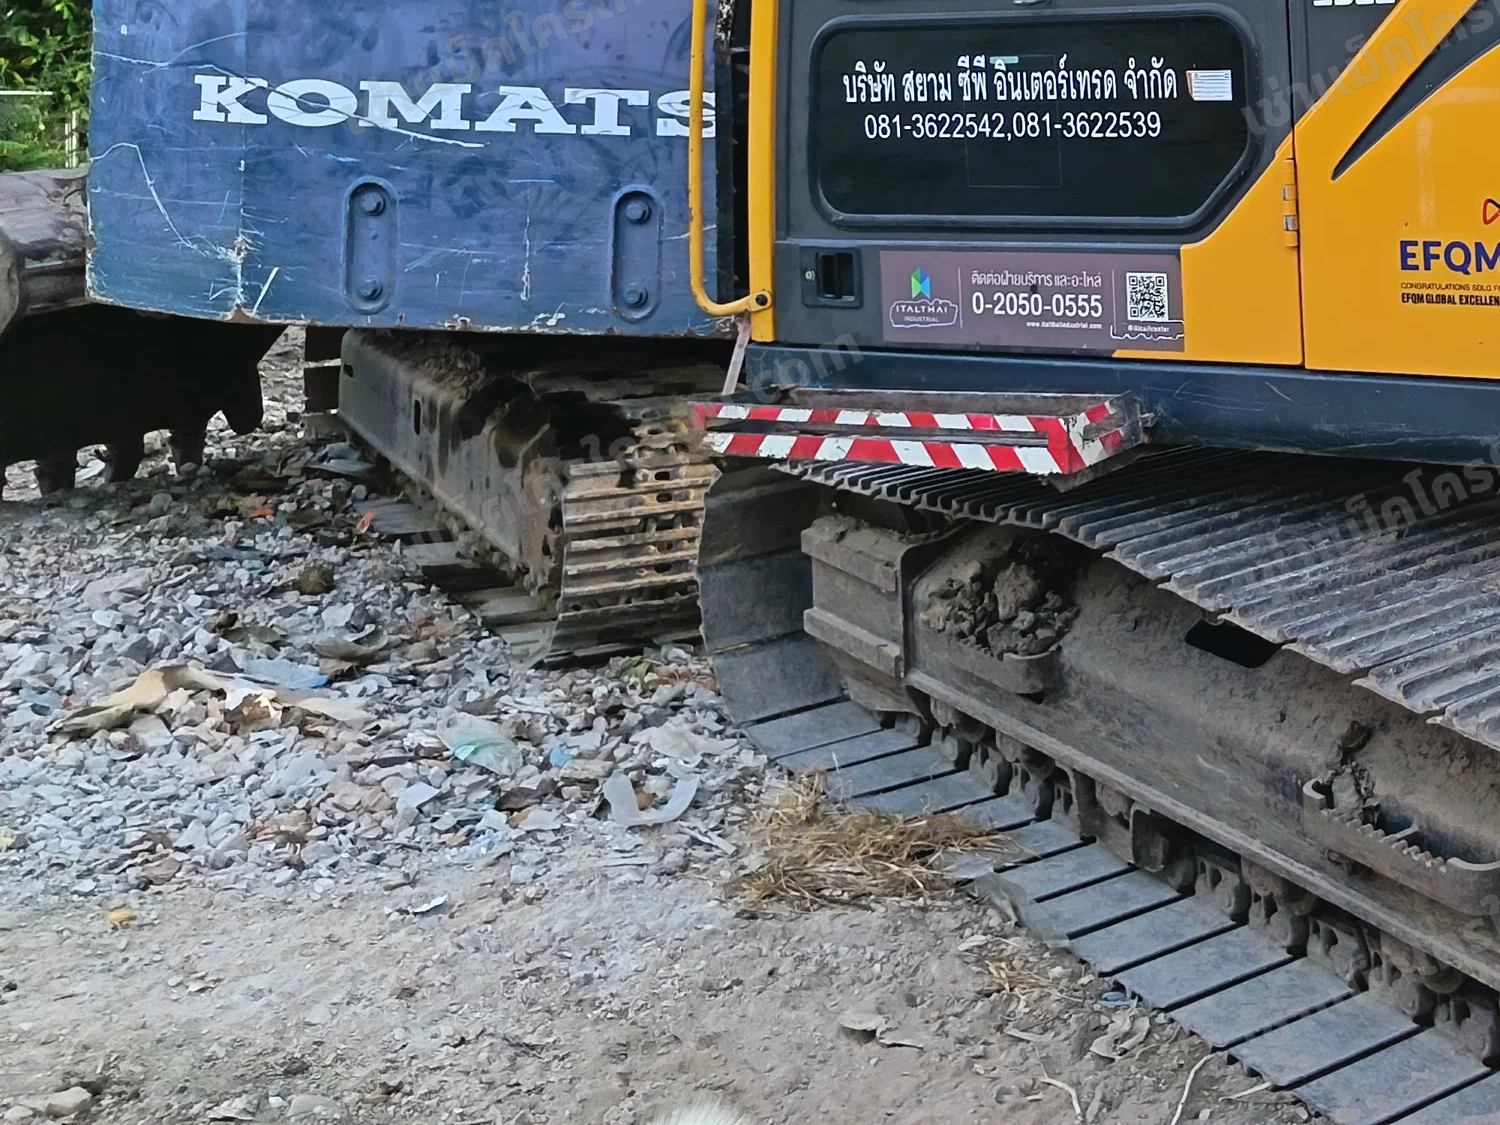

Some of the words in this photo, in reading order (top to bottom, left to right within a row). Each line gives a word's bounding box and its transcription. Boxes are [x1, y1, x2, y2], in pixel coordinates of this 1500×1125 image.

[843, 60, 896, 103] บริษัท
[902, 70, 952, 103] สยาม
[993, 53, 1117, 102] อินเตอร์เทรด
[1124, 56, 1178, 100] จำกัด
[864, 111, 1161, 141] 081-3622542,081-3622539
[1400, 282, 1471, 291] CONGRATULATIONS
[1472, 284, 1492, 292] SDLG
[971, 291, 1103, 318] 0-2050-0555
[1401, 292, 1425, 305] EFQM
[1425, 293, 1457, 305] GLOBAL
[896, 304, 948, 314] ITALTHAI
